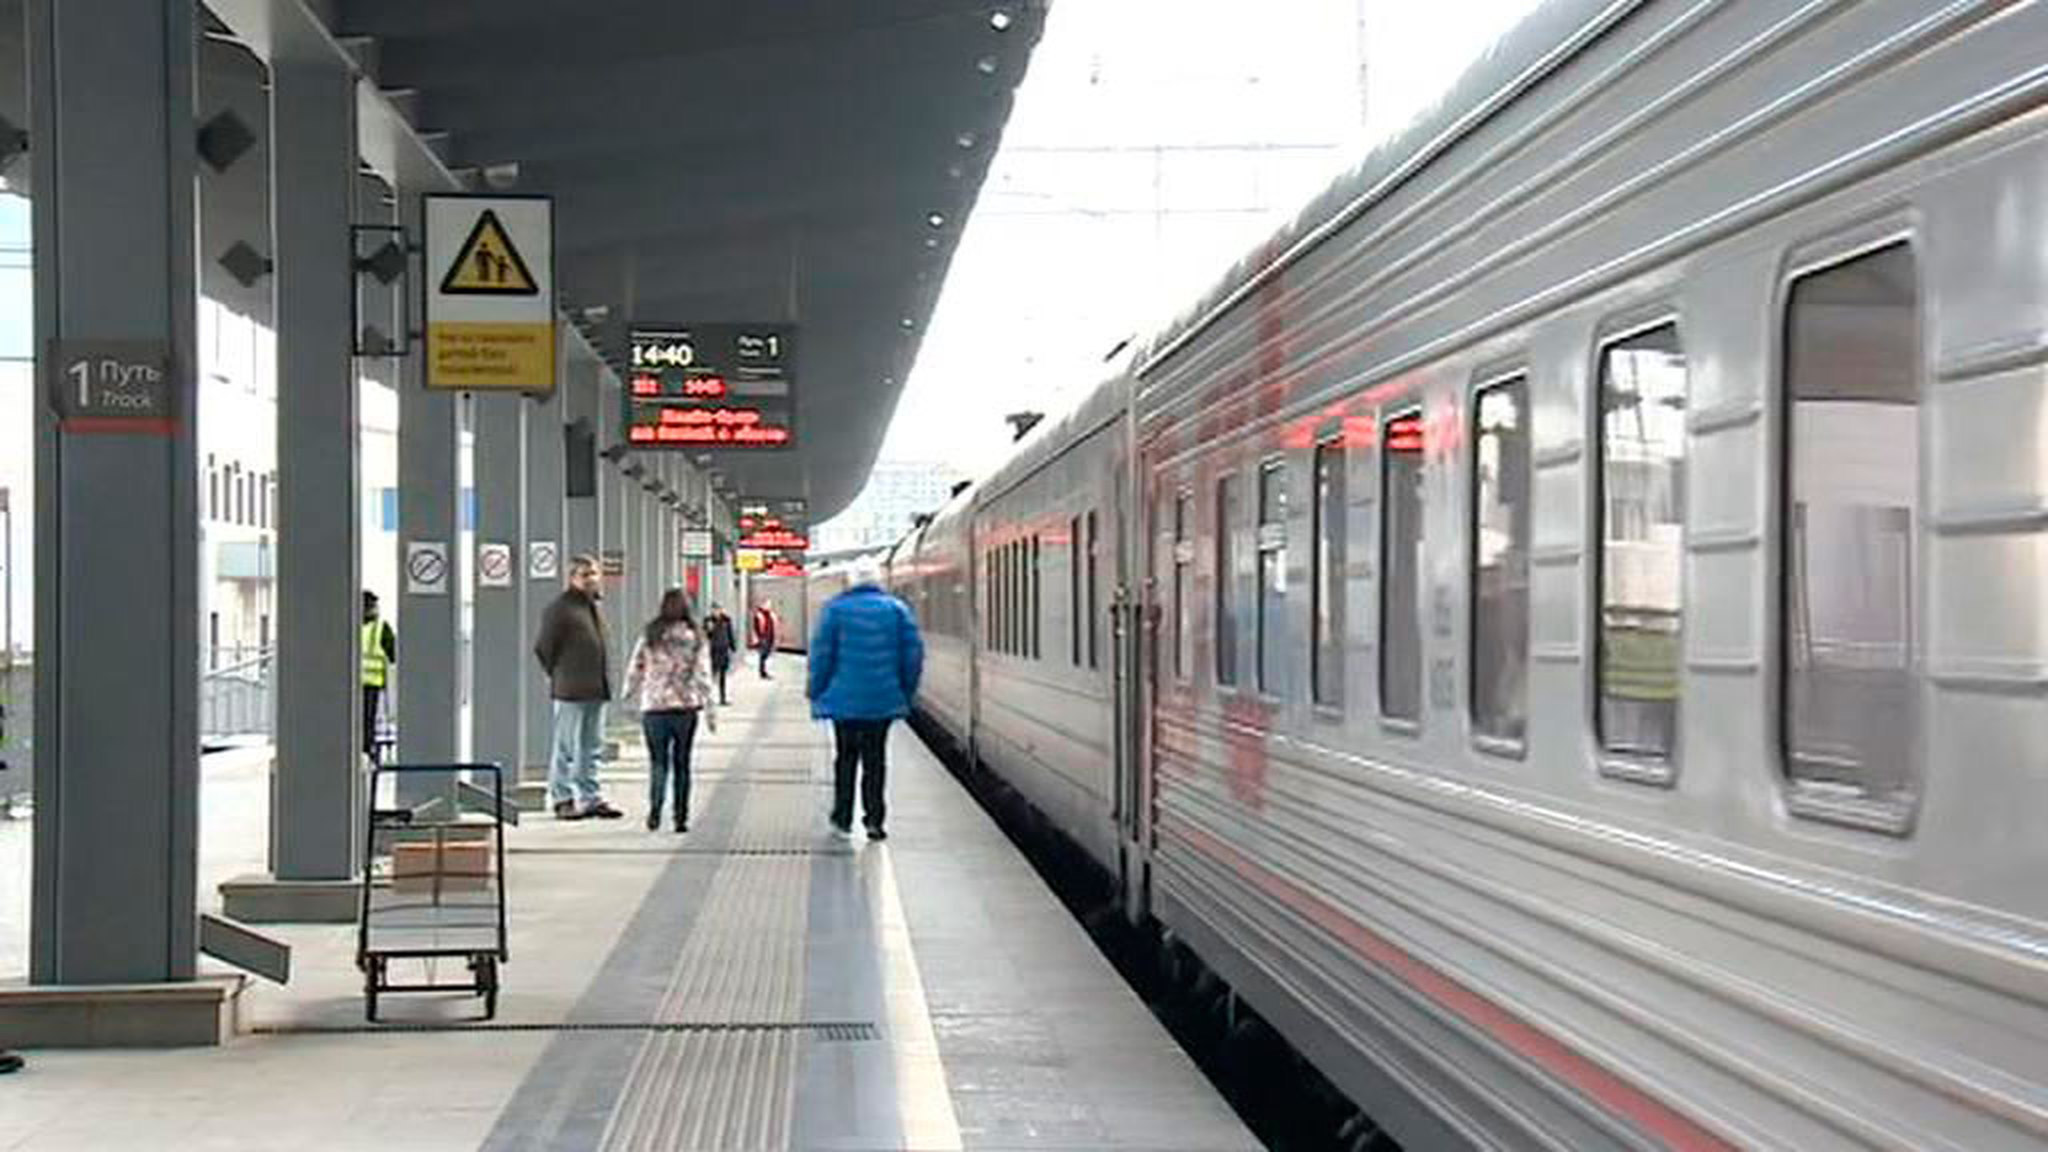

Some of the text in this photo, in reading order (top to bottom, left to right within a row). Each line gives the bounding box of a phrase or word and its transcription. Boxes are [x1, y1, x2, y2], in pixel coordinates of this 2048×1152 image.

[767, 336, 780, 357] 1
[68, 359, 162, 408] 1 Путь
[102, 389, 153, 409] Track
